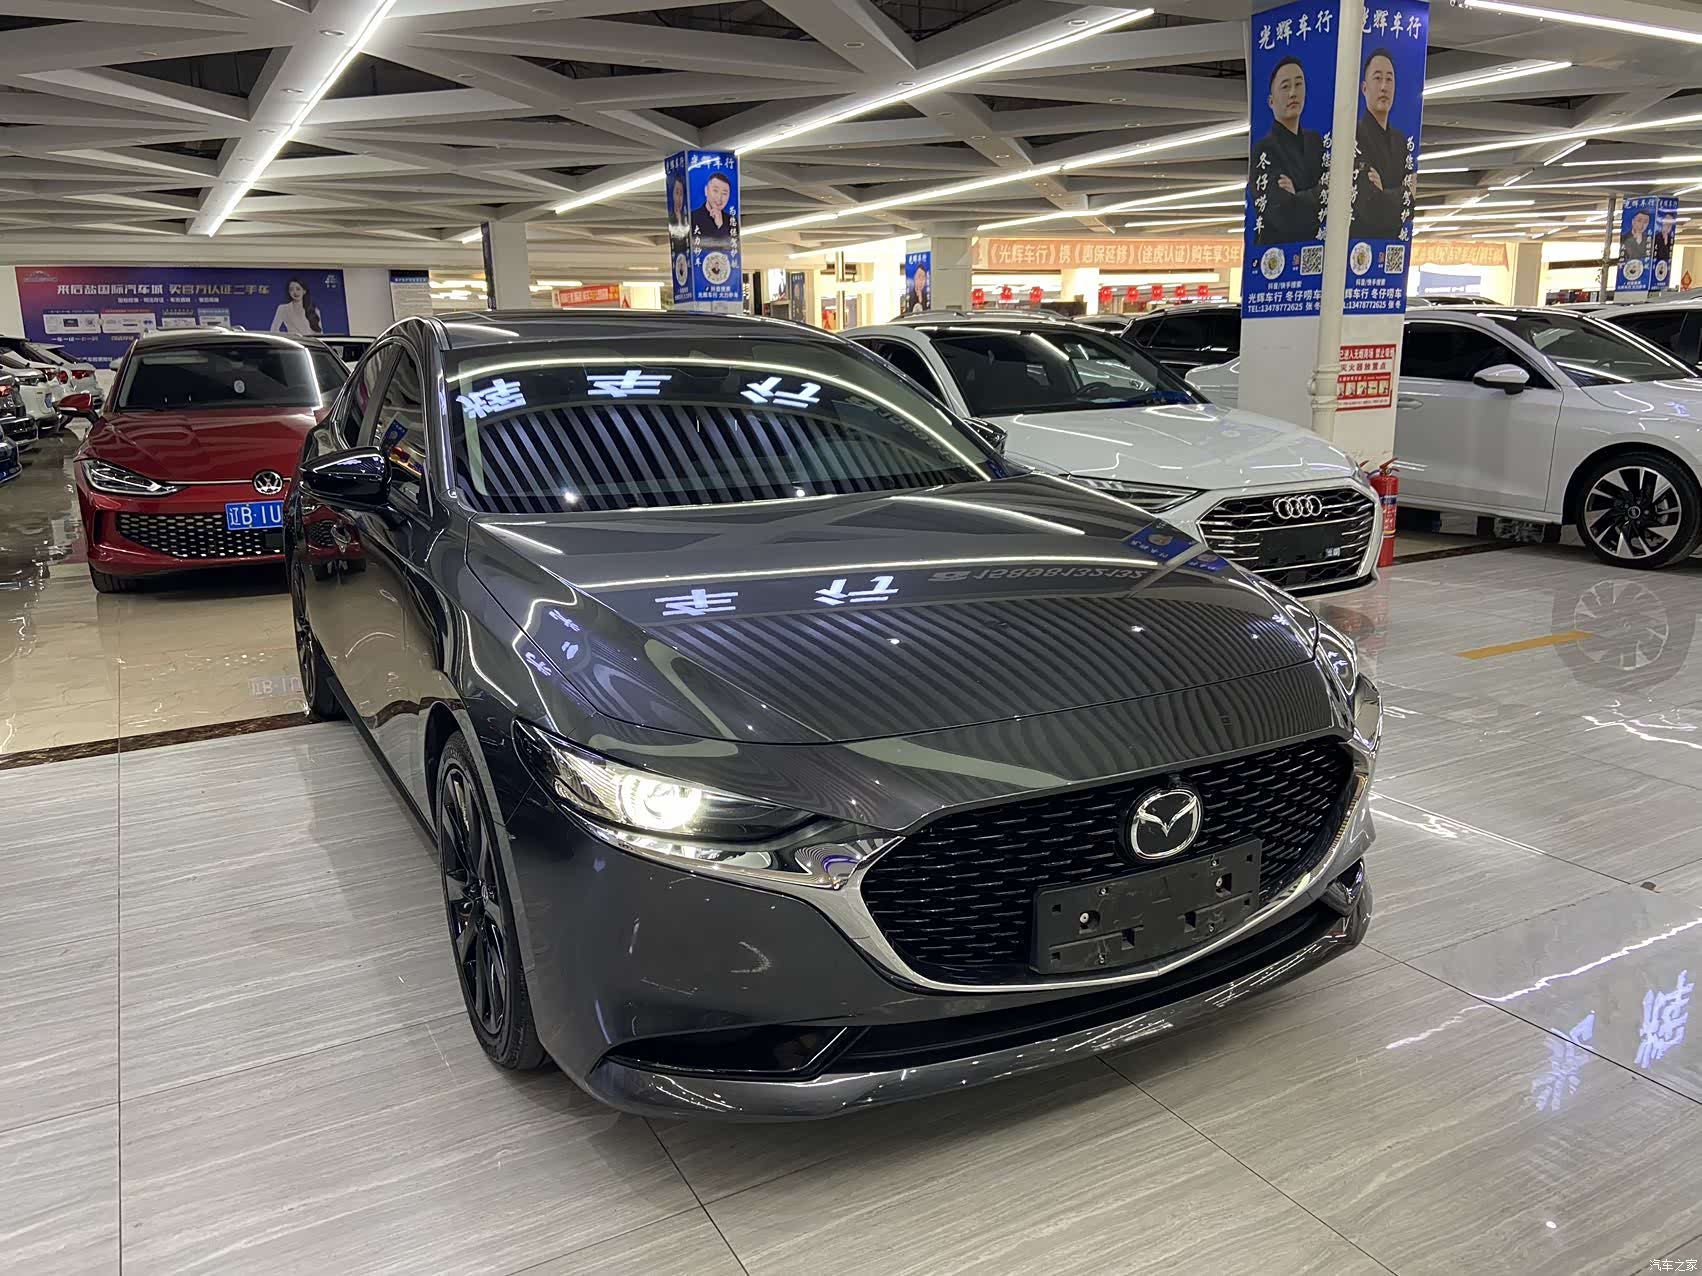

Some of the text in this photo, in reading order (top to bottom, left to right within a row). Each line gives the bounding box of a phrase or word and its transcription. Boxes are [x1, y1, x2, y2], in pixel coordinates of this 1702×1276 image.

[1257, 9, 1334, 50] 光辉车行
[1253, 151, 1272, 235] 冬仔唠车
[1248, 289, 1322, 305] 光辉车行 冬仔唠车
[1248, 303, 1303, 313] TEL:13478772625
